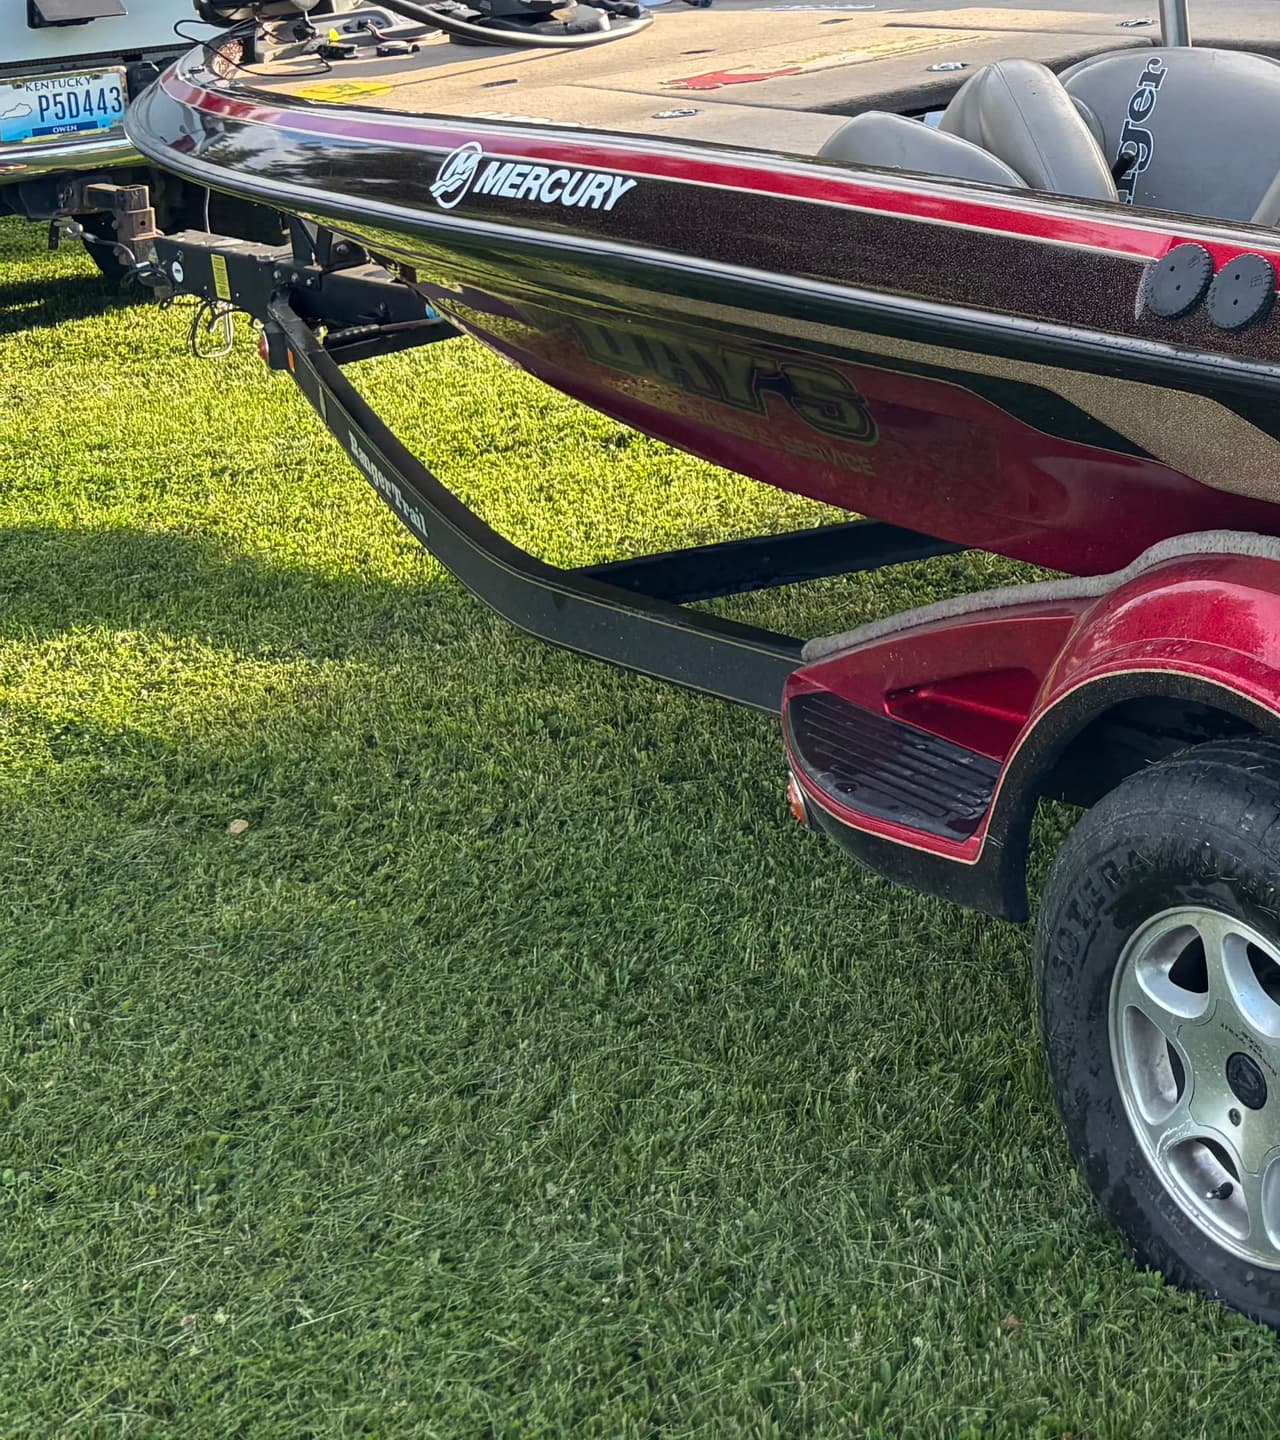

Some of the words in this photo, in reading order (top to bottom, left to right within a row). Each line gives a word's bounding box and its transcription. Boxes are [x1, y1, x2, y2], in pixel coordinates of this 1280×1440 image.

[25, 74, 93, 93] KENTUCKY
[38, 86, 122, 123] P5D443
[52, 124, 77, 134] OWEN
[473, 161, 638, 211] MERCURY
